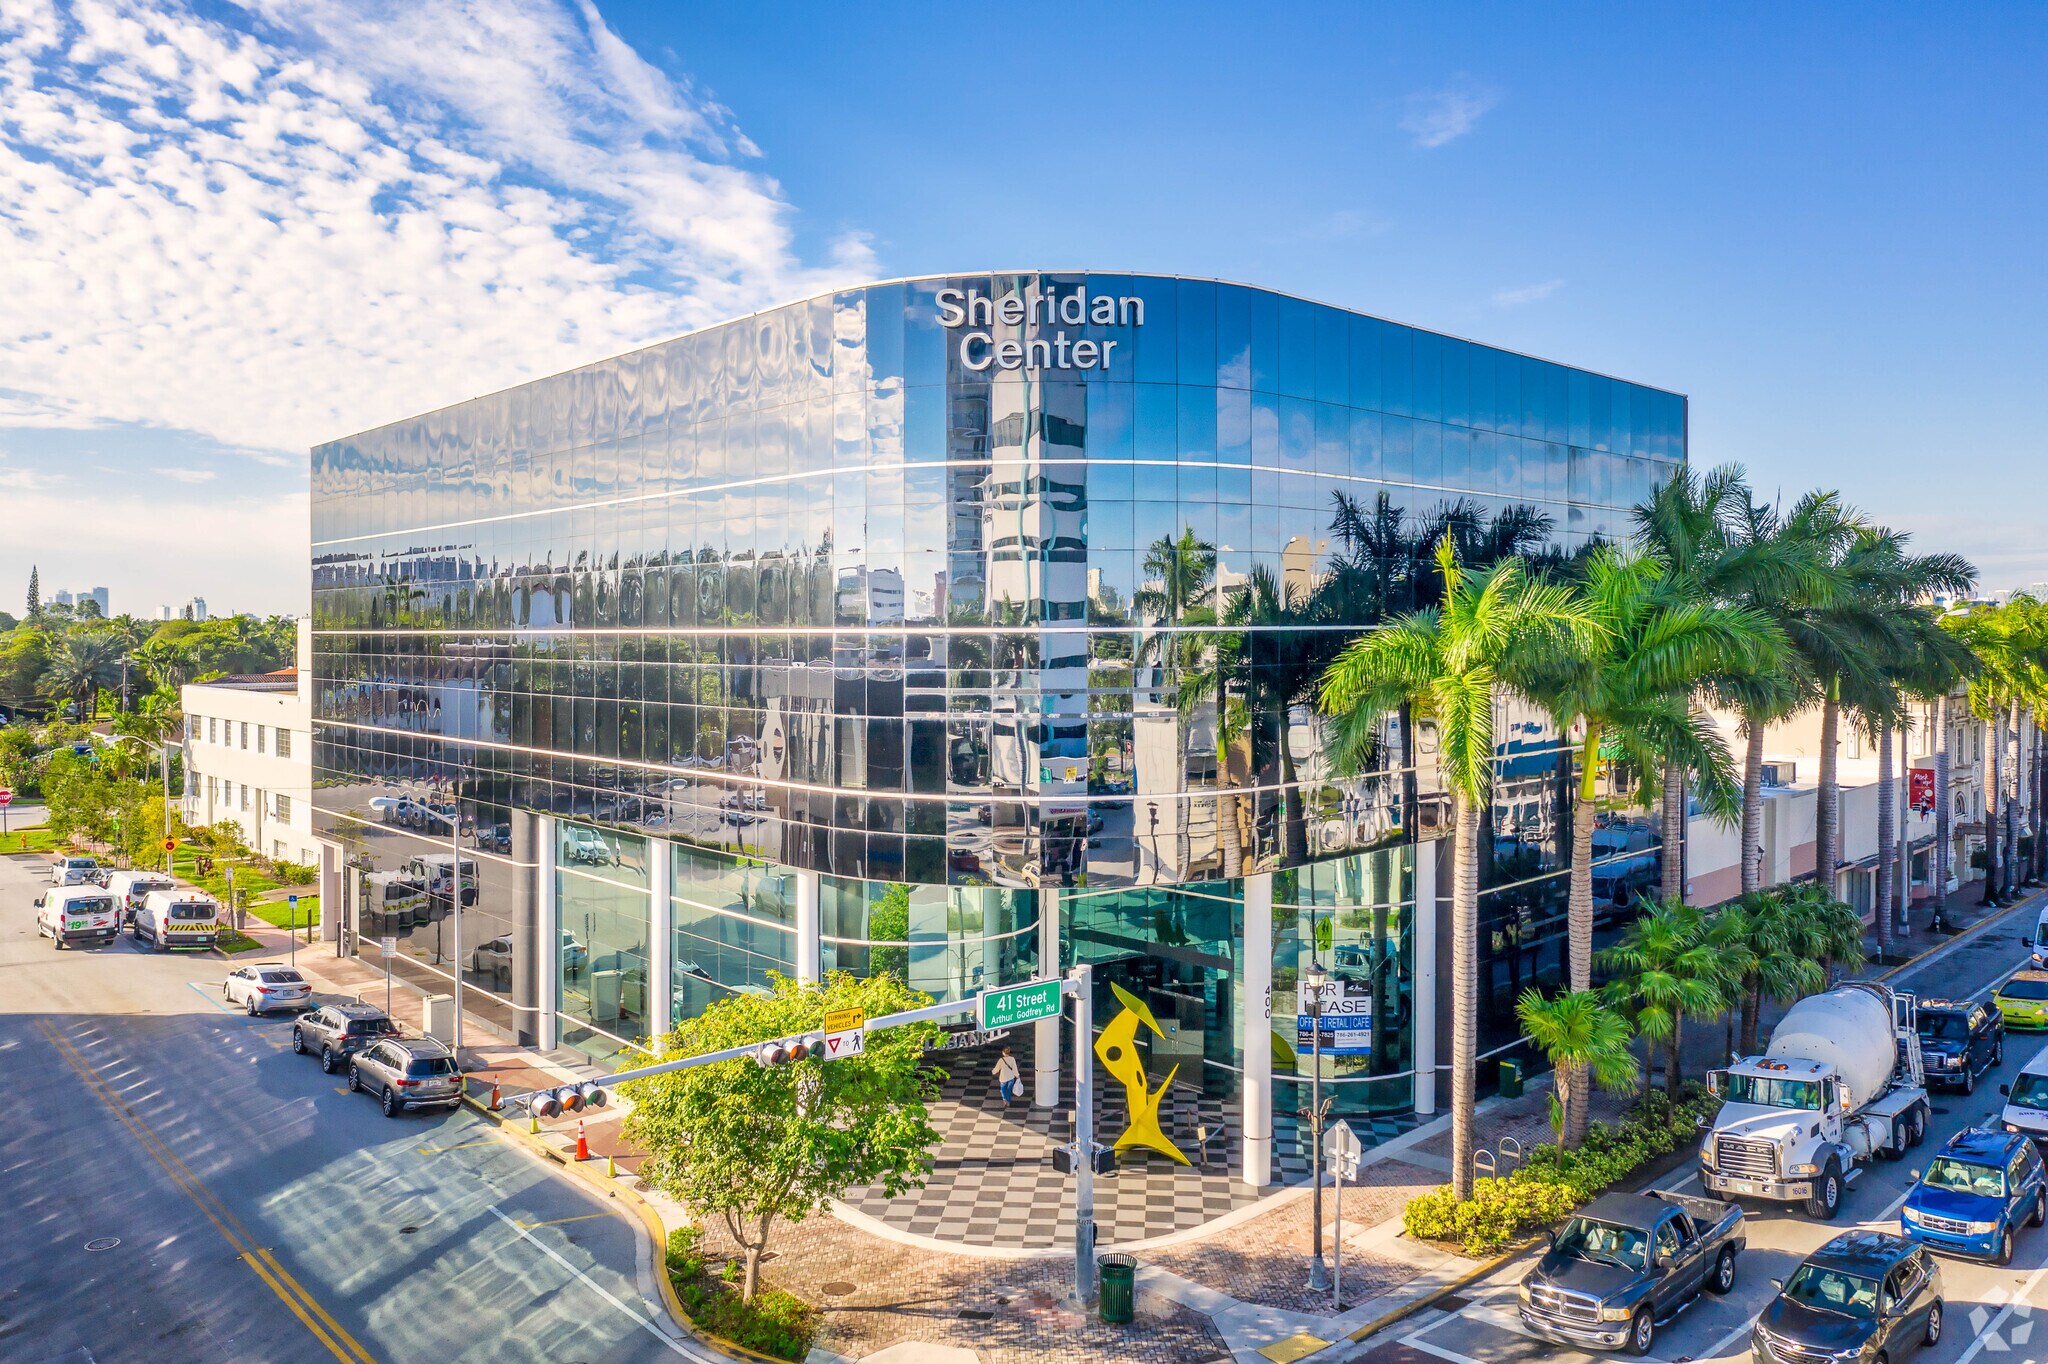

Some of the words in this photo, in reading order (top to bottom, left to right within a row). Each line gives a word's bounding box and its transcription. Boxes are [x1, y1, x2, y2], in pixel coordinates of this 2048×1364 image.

[935, 286, 1144, 327] Sheridan
[960, 331, 1117, 371] Center
[997, 994, 1012, 1011] 41
[1016, 990, 1047, 1008] Street
[828, 1013, 850, 1021] TURNING
[991, 1014, 1013, 1025] Arthur
[1017, 1007, 1043, 1019] Godfrey
[1046, 1004, 1055, 1012] Rd
[827, 1021, 851, 1030] VEHICLES
[1299, 1017, 1323, 1028] OFFE
[1328, 1017, 1349, 1028] RETAIL
[1353, 1015, 1370, 1028] CAFÉ
[1723, 1143, 1769, 1153] MACK
[1792, 1187, 1807, 1195] 16016
